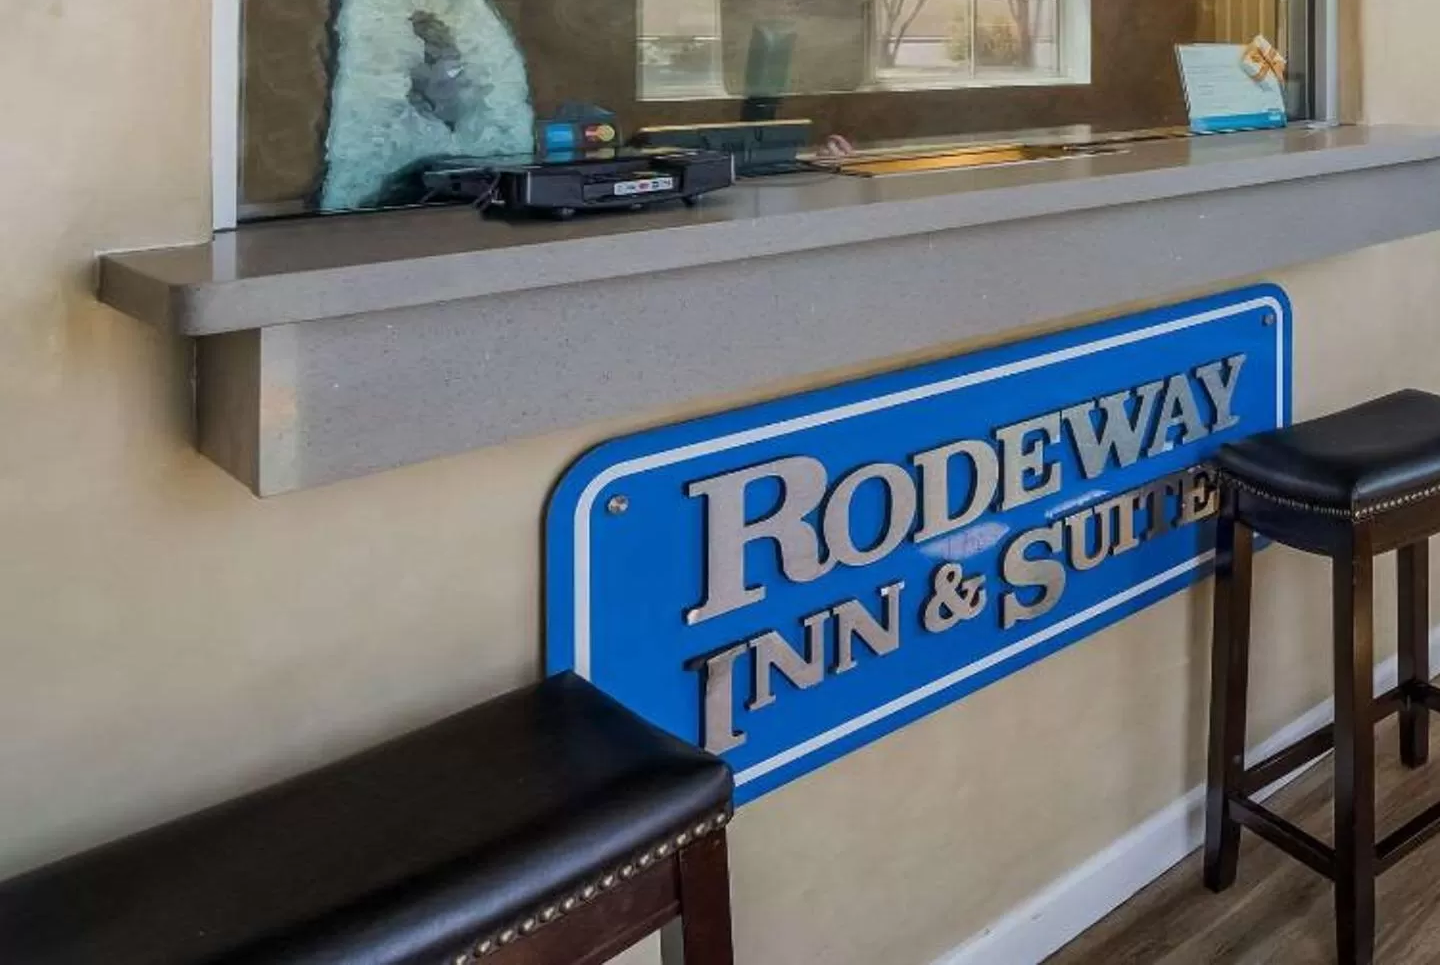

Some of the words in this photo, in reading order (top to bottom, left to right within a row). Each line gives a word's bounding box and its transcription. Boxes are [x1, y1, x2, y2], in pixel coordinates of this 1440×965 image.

[683, 353, 1247, 626] RODEWAY
[687, 581, 905, 756] INN
[922, 562, 989, 633] &
[1001, 461, 1221, 630] SUITE
